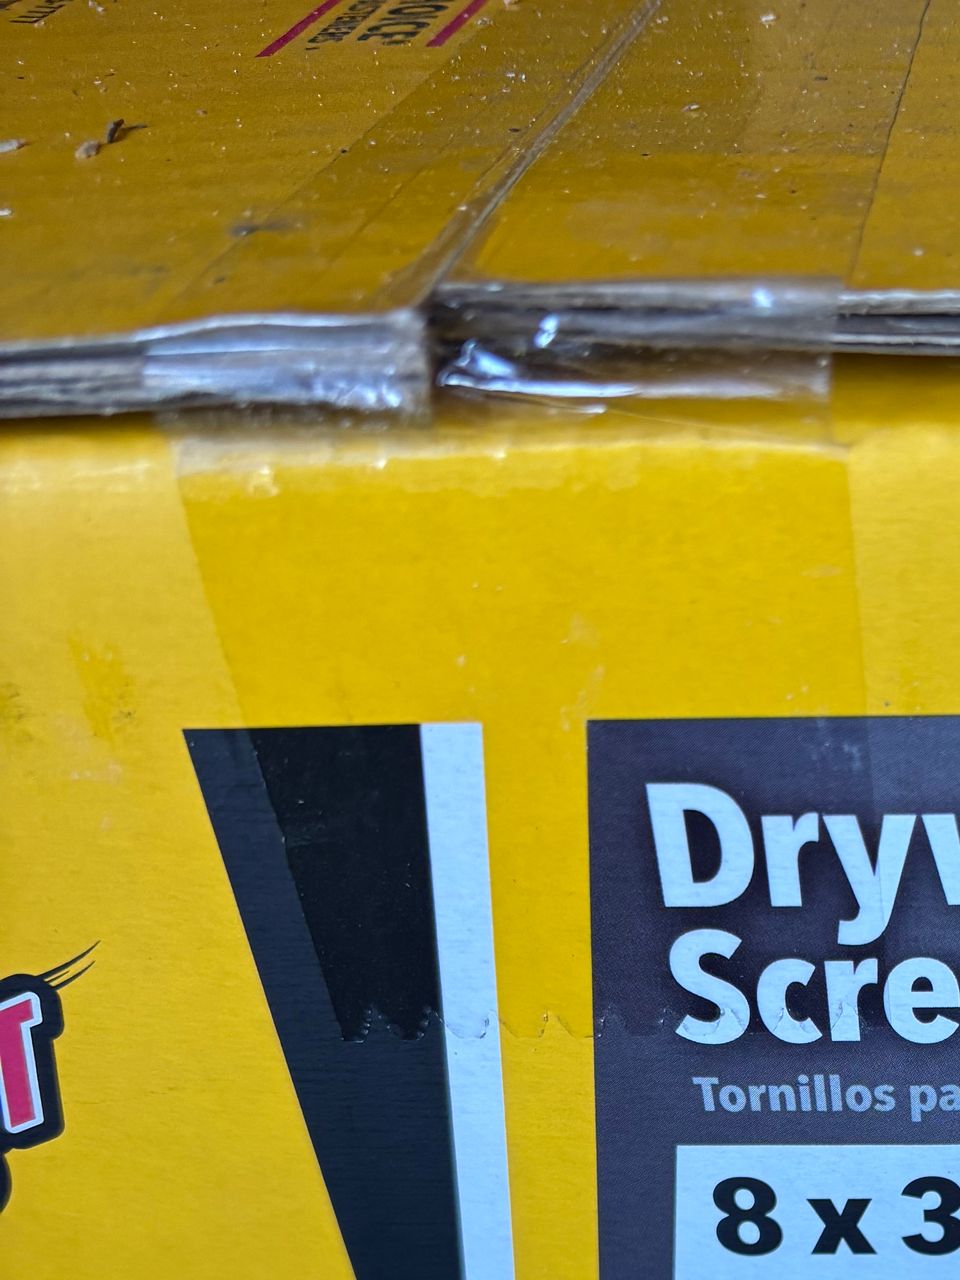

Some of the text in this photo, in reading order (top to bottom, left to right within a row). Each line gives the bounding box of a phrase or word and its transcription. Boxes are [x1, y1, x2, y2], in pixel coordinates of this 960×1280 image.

[692, 1073, 896, 1114] Tornillos
[712, 1176, 784, 1256] 8
[806, 1198, 876, 1255] x
